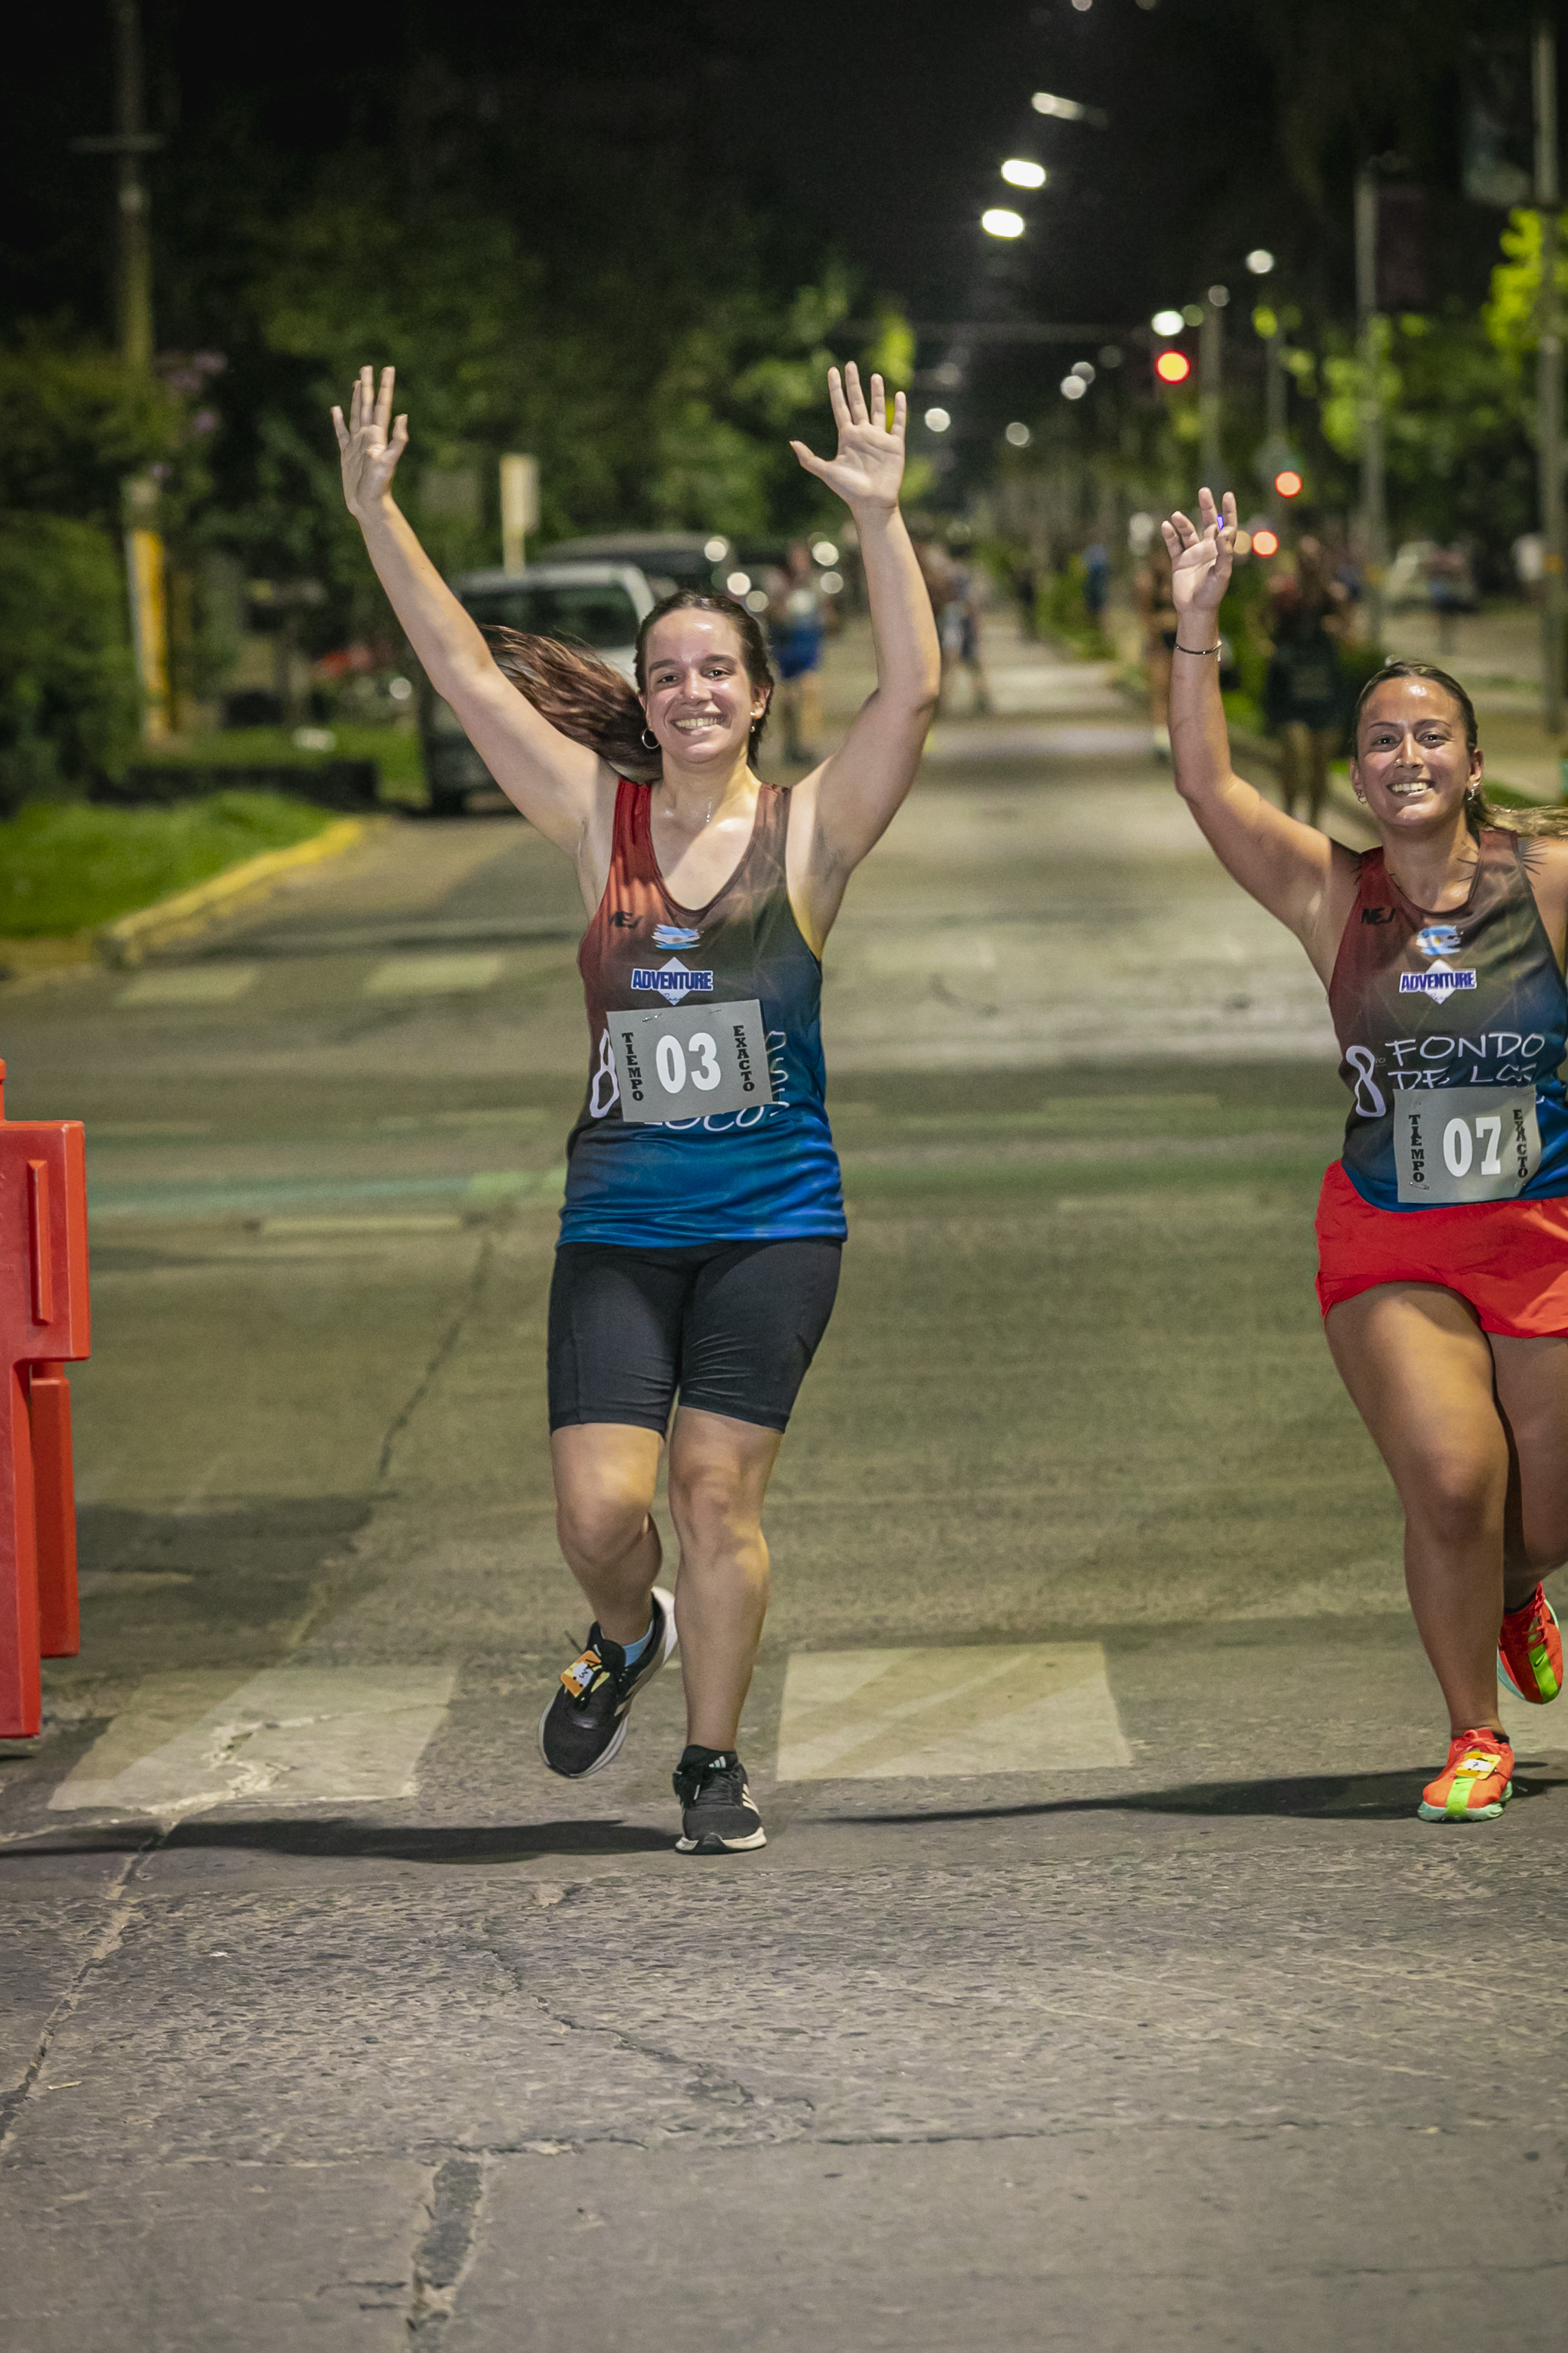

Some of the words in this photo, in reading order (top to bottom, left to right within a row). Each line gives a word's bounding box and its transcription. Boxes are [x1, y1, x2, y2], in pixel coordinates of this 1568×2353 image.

[632, 970, 713, 991] ADVENTURE
[1401, 970, 1475, 991] ADVENTURE
[590, 1028, 620, 1118] 8
[621, 1032, 644, 1101] TIEMPO
[656, 1032, 721, 1093] 03
[733, 1025, 755, 1091] EXACTO
[1385, 1033, 1545, 1066] FONDO
[1388, 1066, 1449, 1090] DE
[1346, 1046, 1386, 1117] 8
[1409, 1114, 1425, 1183] TIEMPO
[1443, 1116, 1502, 1177] 07
[1513, 1109, 1528, 1178] EXACTO
